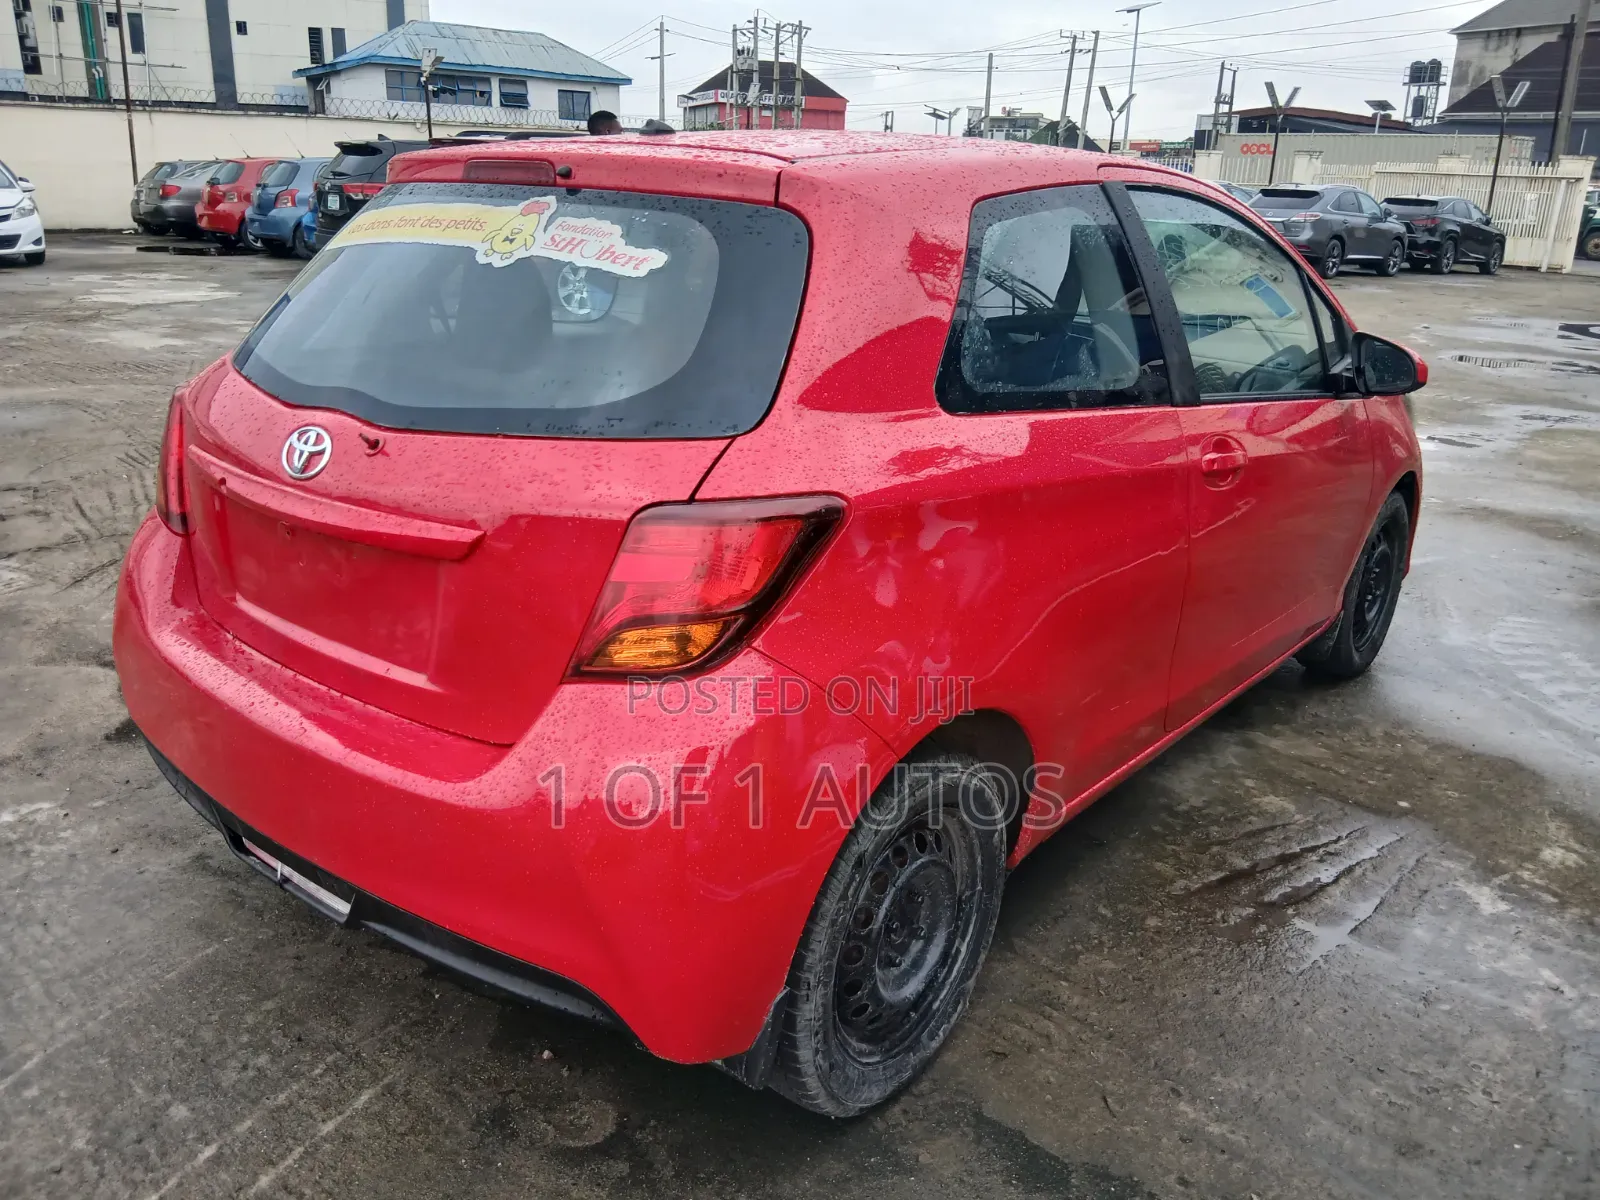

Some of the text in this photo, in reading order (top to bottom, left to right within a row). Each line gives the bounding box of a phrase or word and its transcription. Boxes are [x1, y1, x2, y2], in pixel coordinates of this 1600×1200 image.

[1240, 143, 1275, 155] OOCL
[420, 215, 446, 229] des
[555, 220, 614, 239] Fondation
